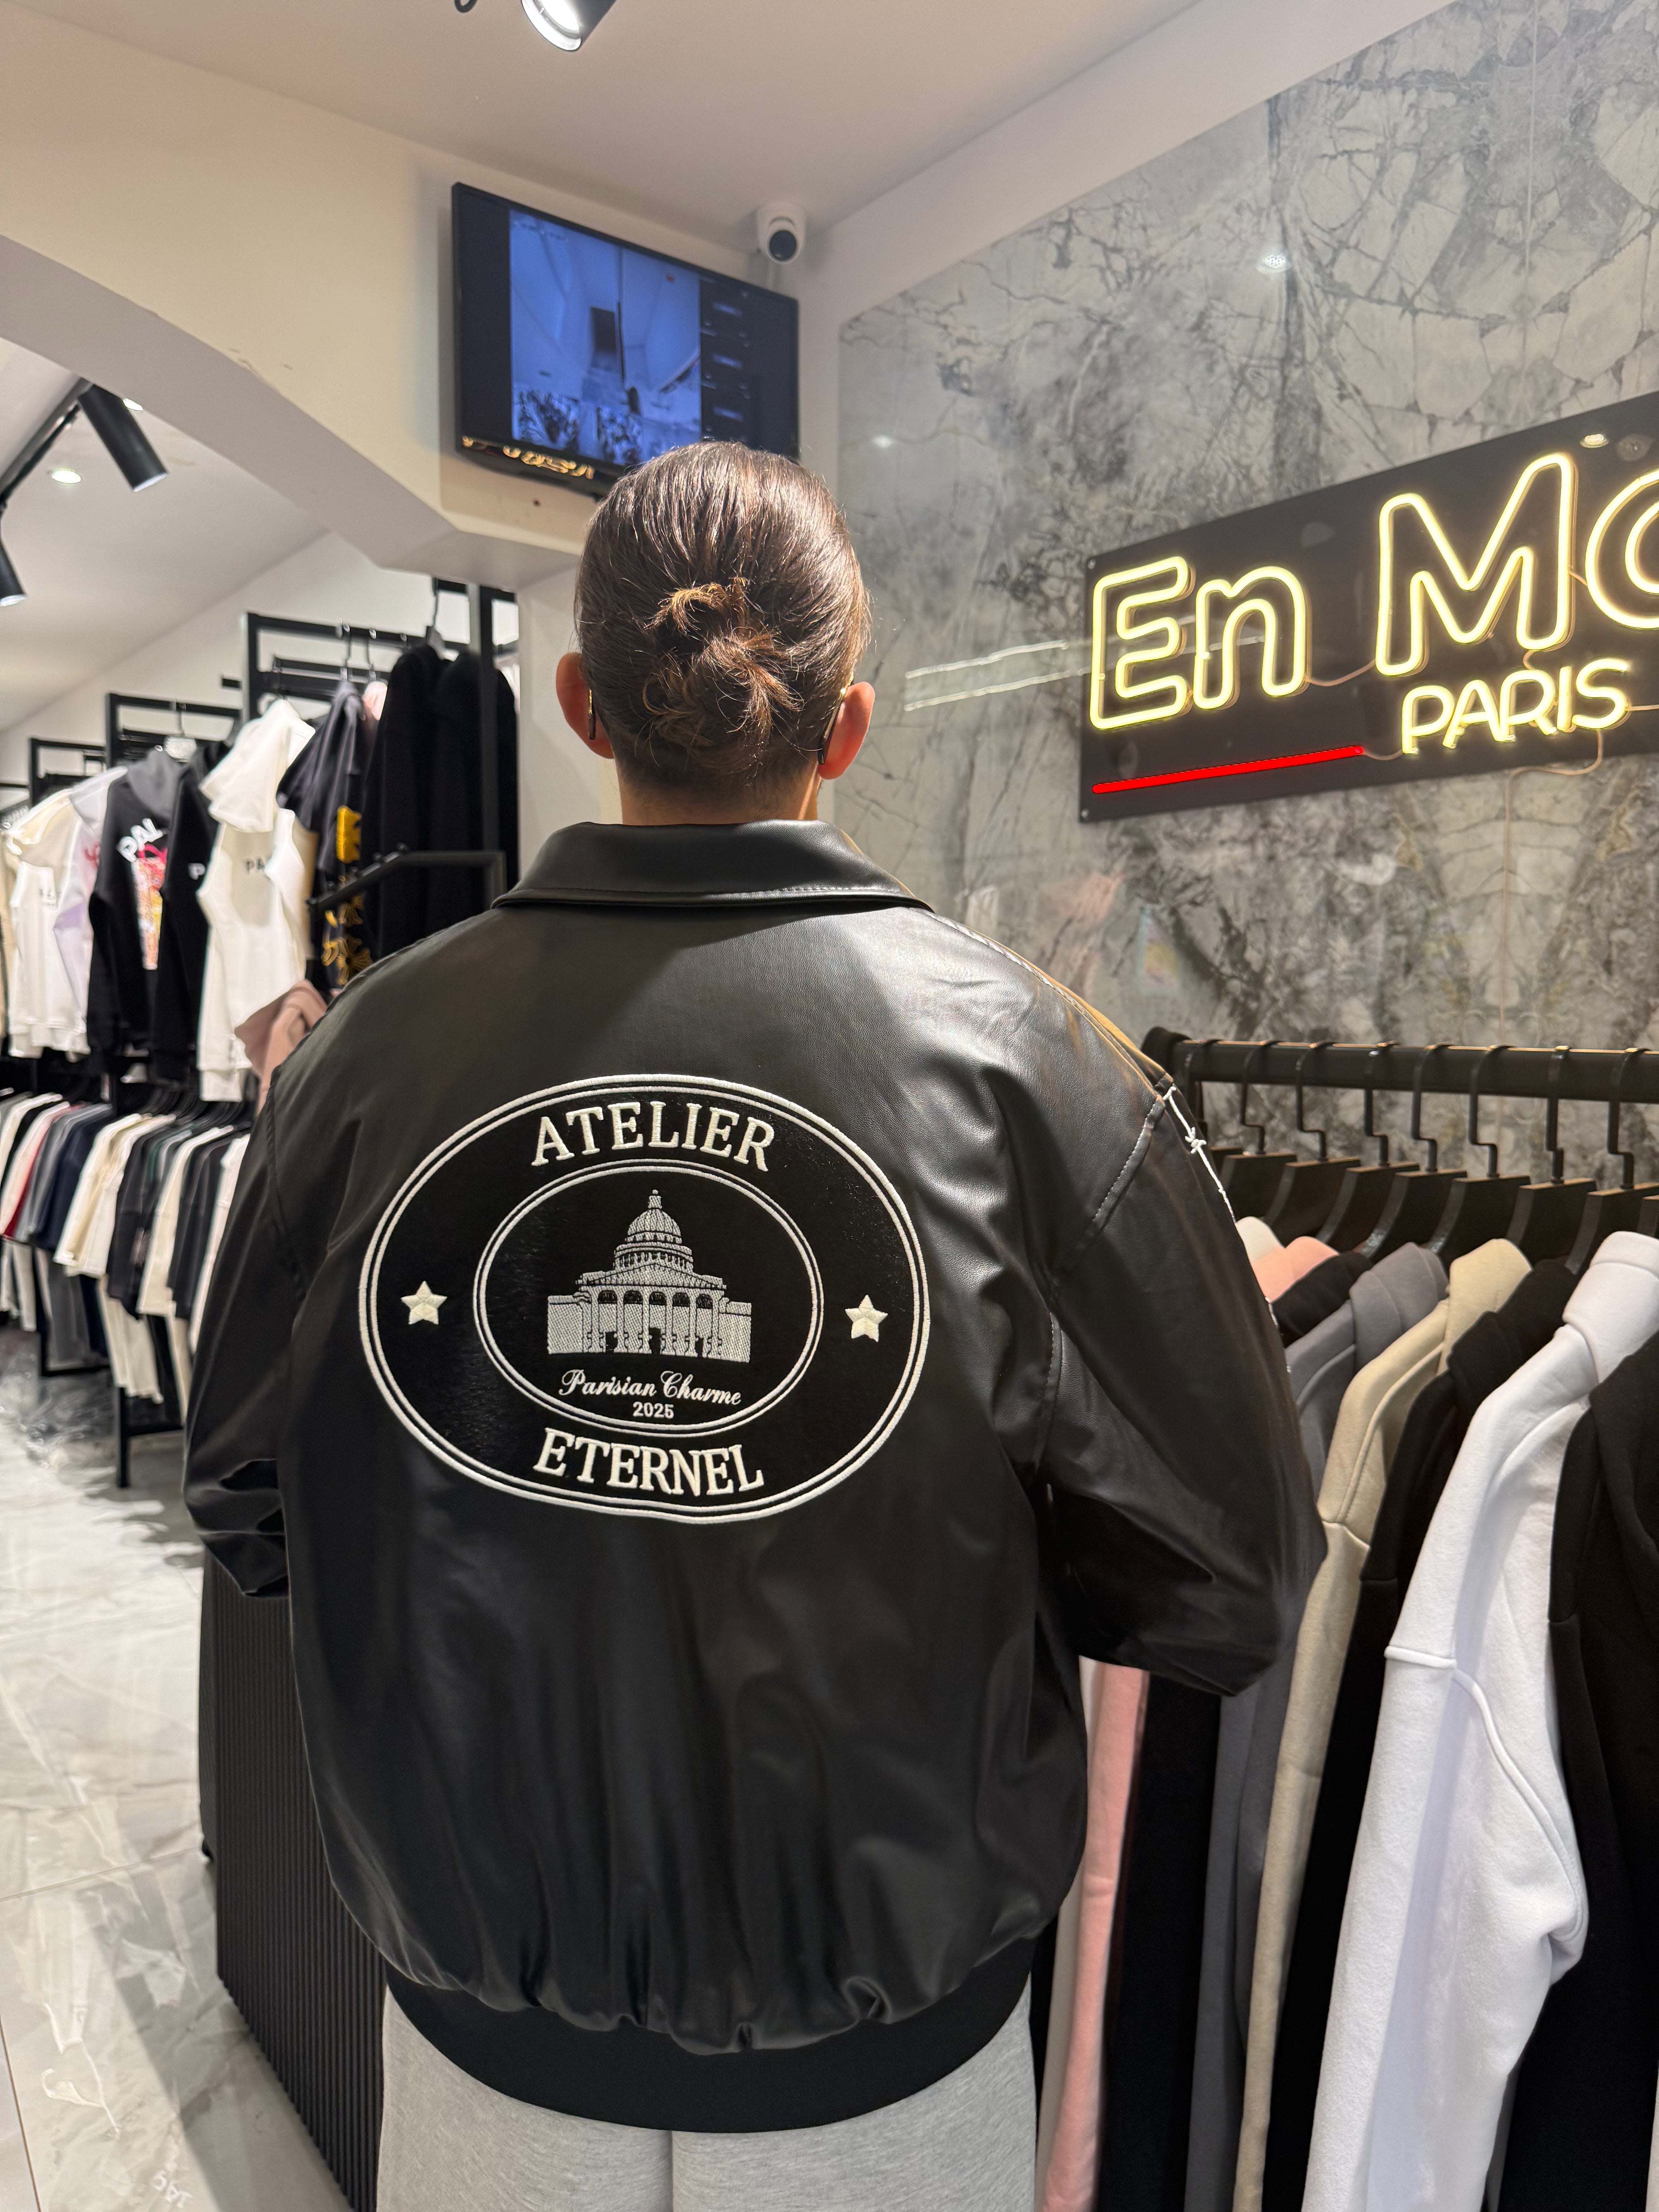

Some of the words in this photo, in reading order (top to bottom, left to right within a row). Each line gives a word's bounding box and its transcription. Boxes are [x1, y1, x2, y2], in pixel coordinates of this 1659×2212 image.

[1089, 555, 1311, 730] En
[1402, 658, 1630, 754] PARIS
[531, 1101, 775, 1172] ATELIER
[558, 1369, 658, 1396] Parisian
[659, 1370, 742, 1405] Charme
[632, 1401, 675, 1419] 2025
[534, 1427, 765, 1497] ETERNEL
